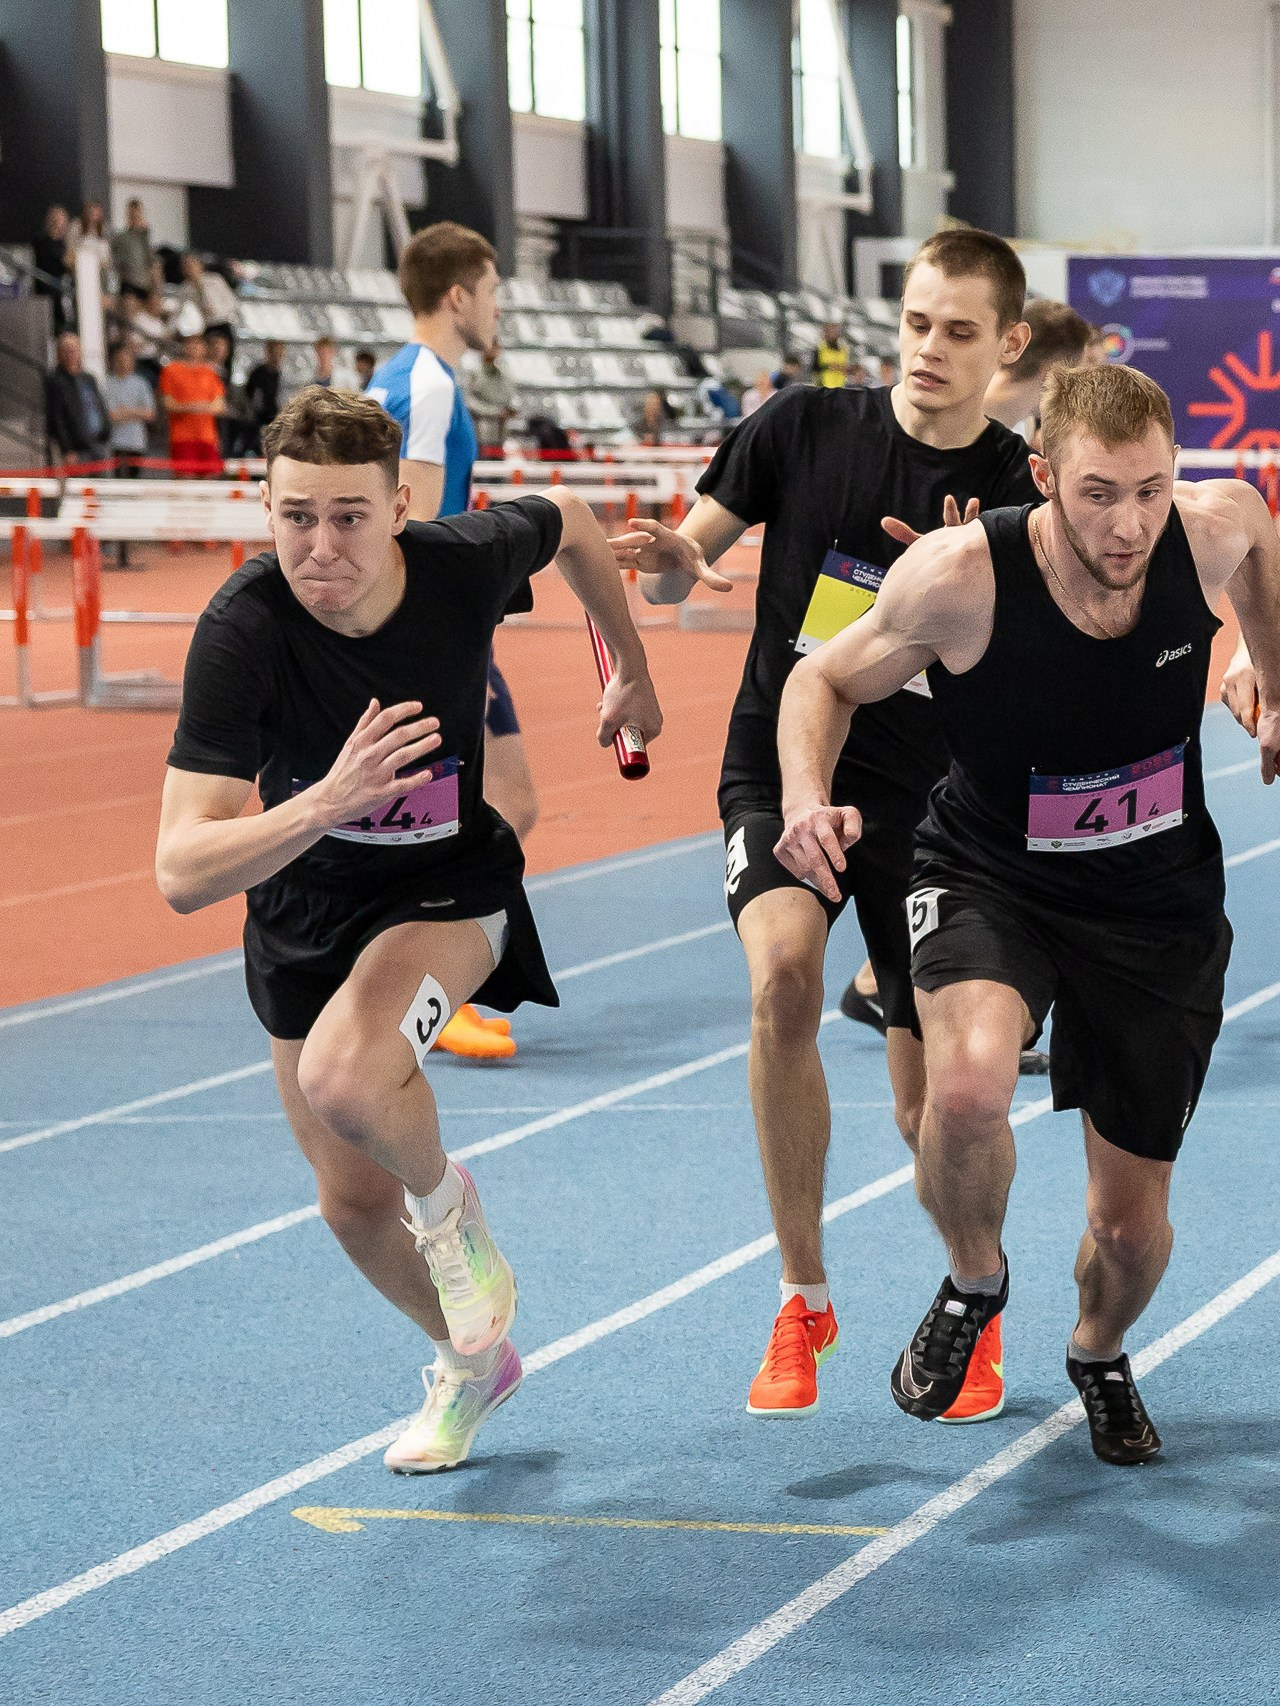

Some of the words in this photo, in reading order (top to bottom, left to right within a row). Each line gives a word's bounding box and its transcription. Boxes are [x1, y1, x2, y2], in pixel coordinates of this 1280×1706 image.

[421, 812, 433, 825] 4
[1073, 788, 1138, 833] 41
[1148, 803, 1160, 817] 4
[912, 889, 935, 934] 5
[416, 997, 442, 1045] 3
